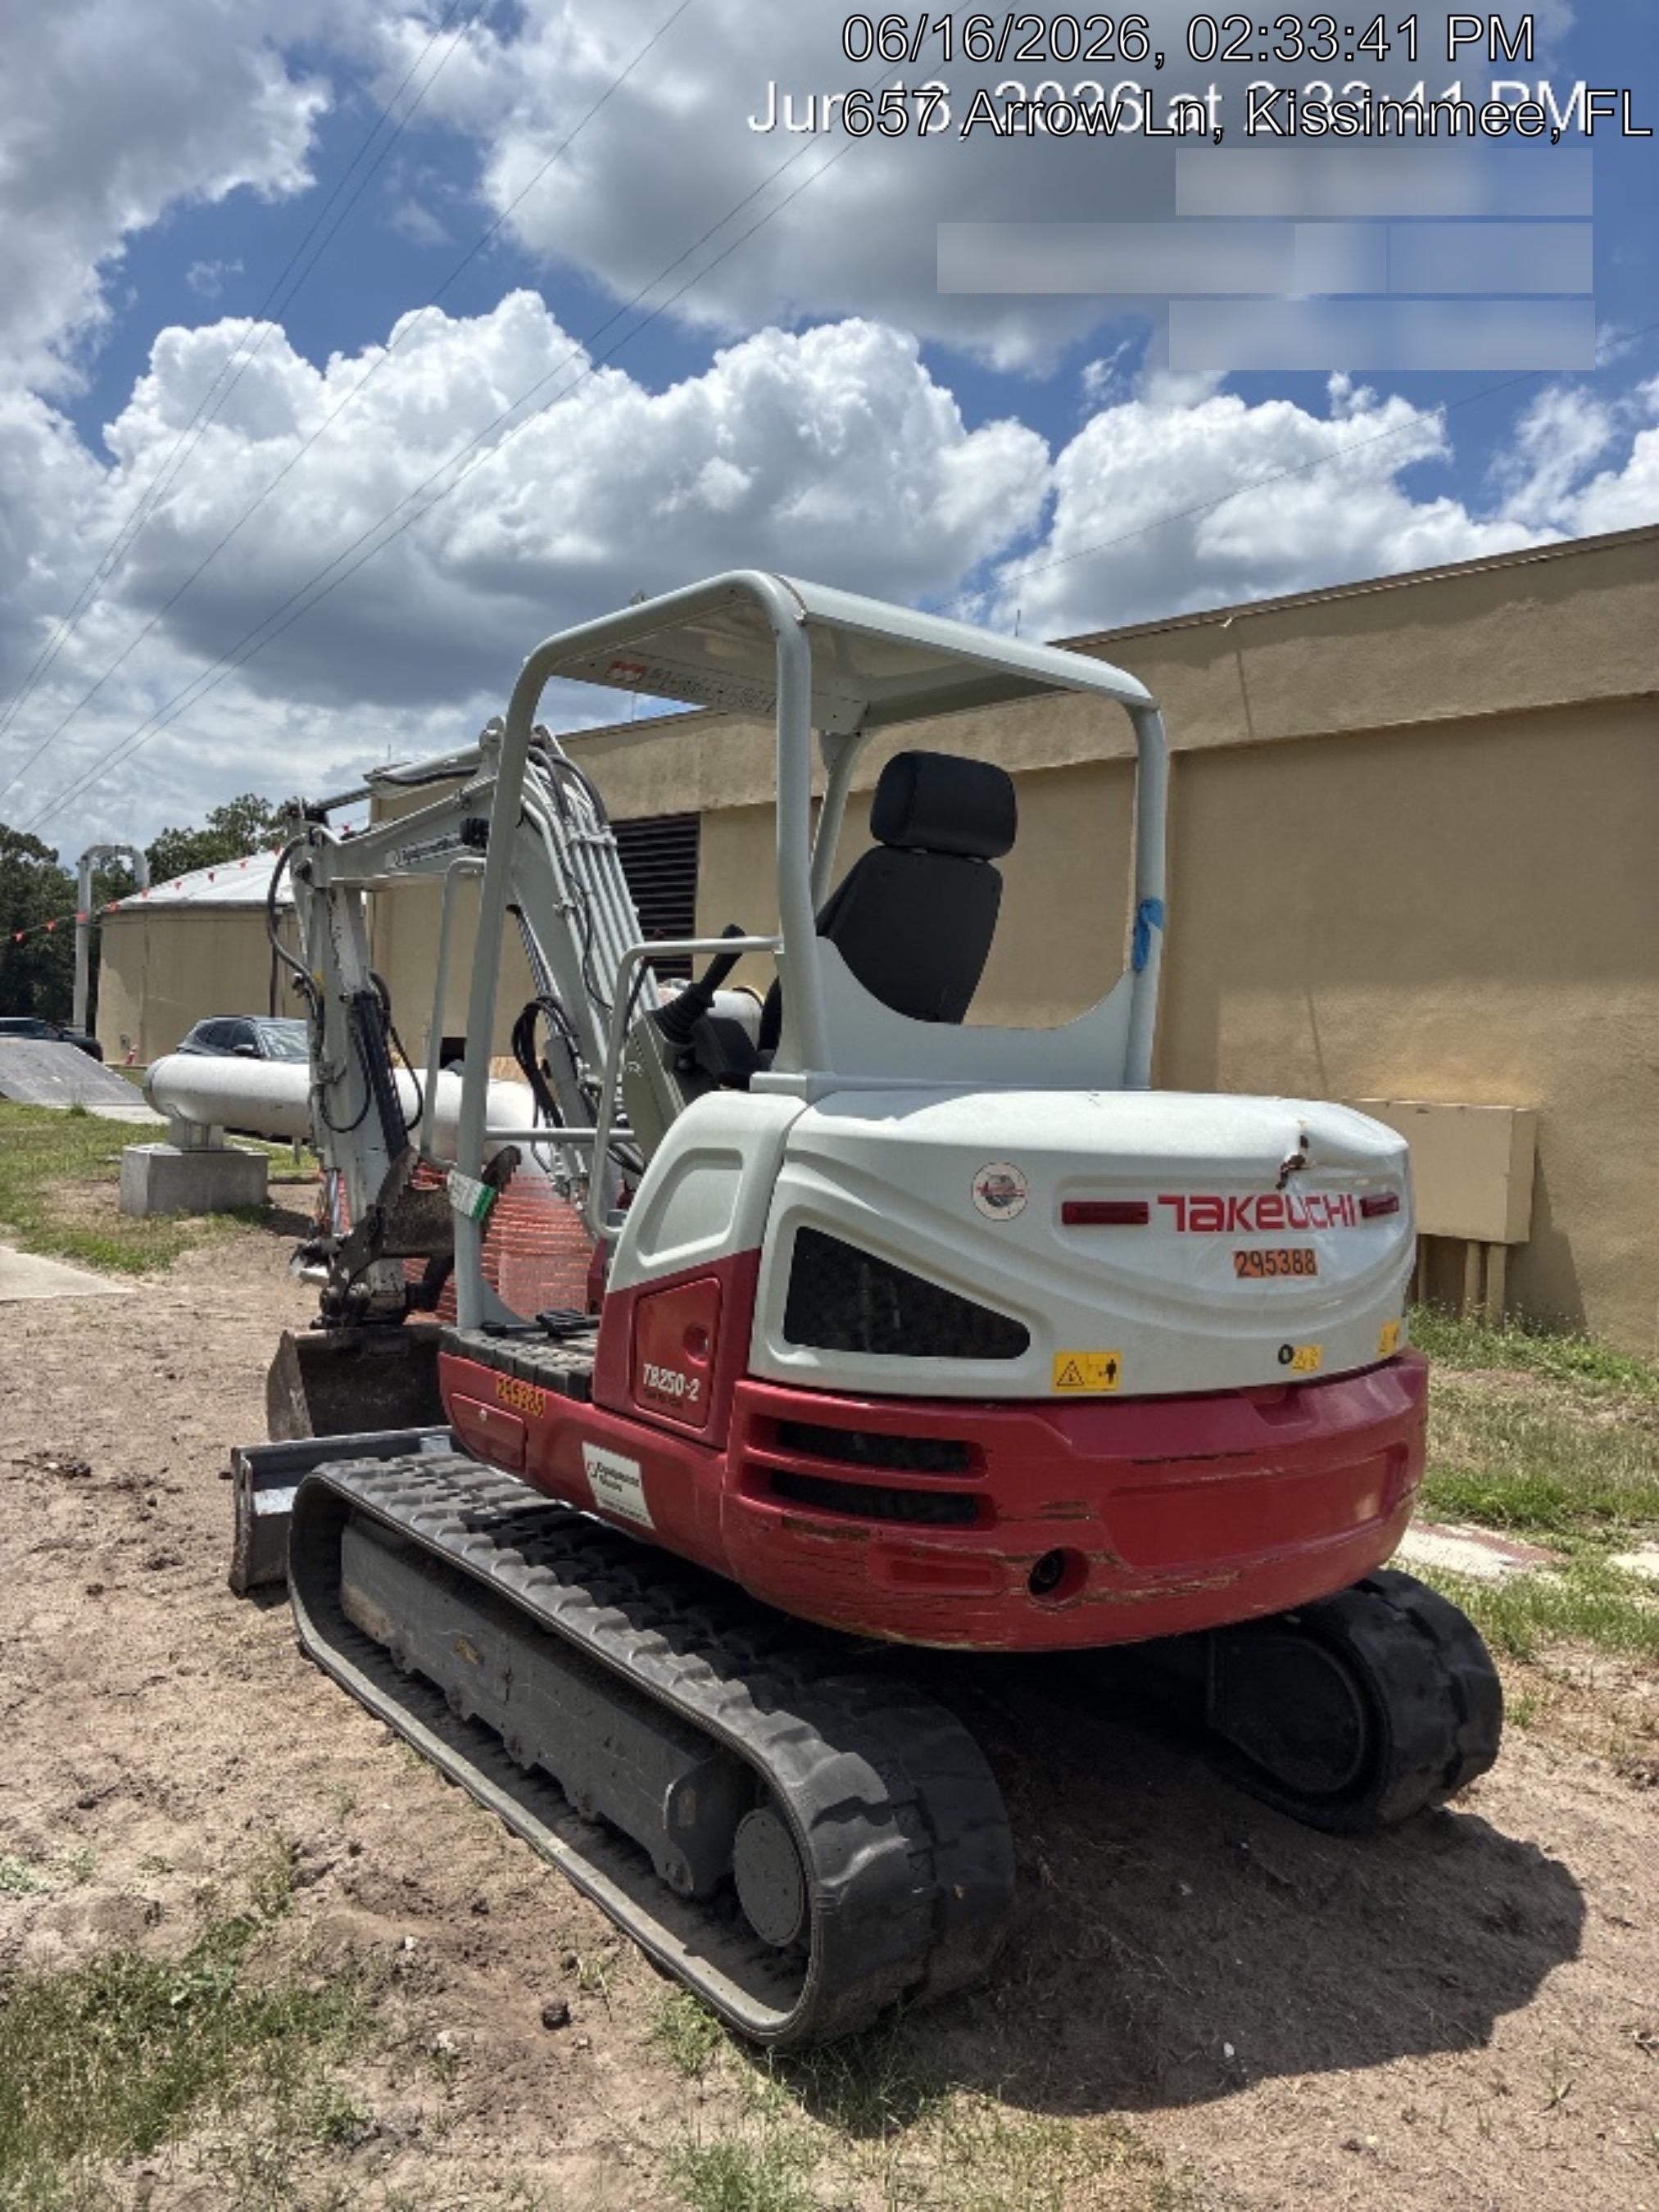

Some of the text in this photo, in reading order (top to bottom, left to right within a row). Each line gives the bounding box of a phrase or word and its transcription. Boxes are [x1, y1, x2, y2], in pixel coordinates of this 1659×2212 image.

[1157, 1193, 1358, 1232] TAKEUCHI
[1235, 1248, 1317, 1276] 295388
[642, 1363, 701, 1403] TB250-2
